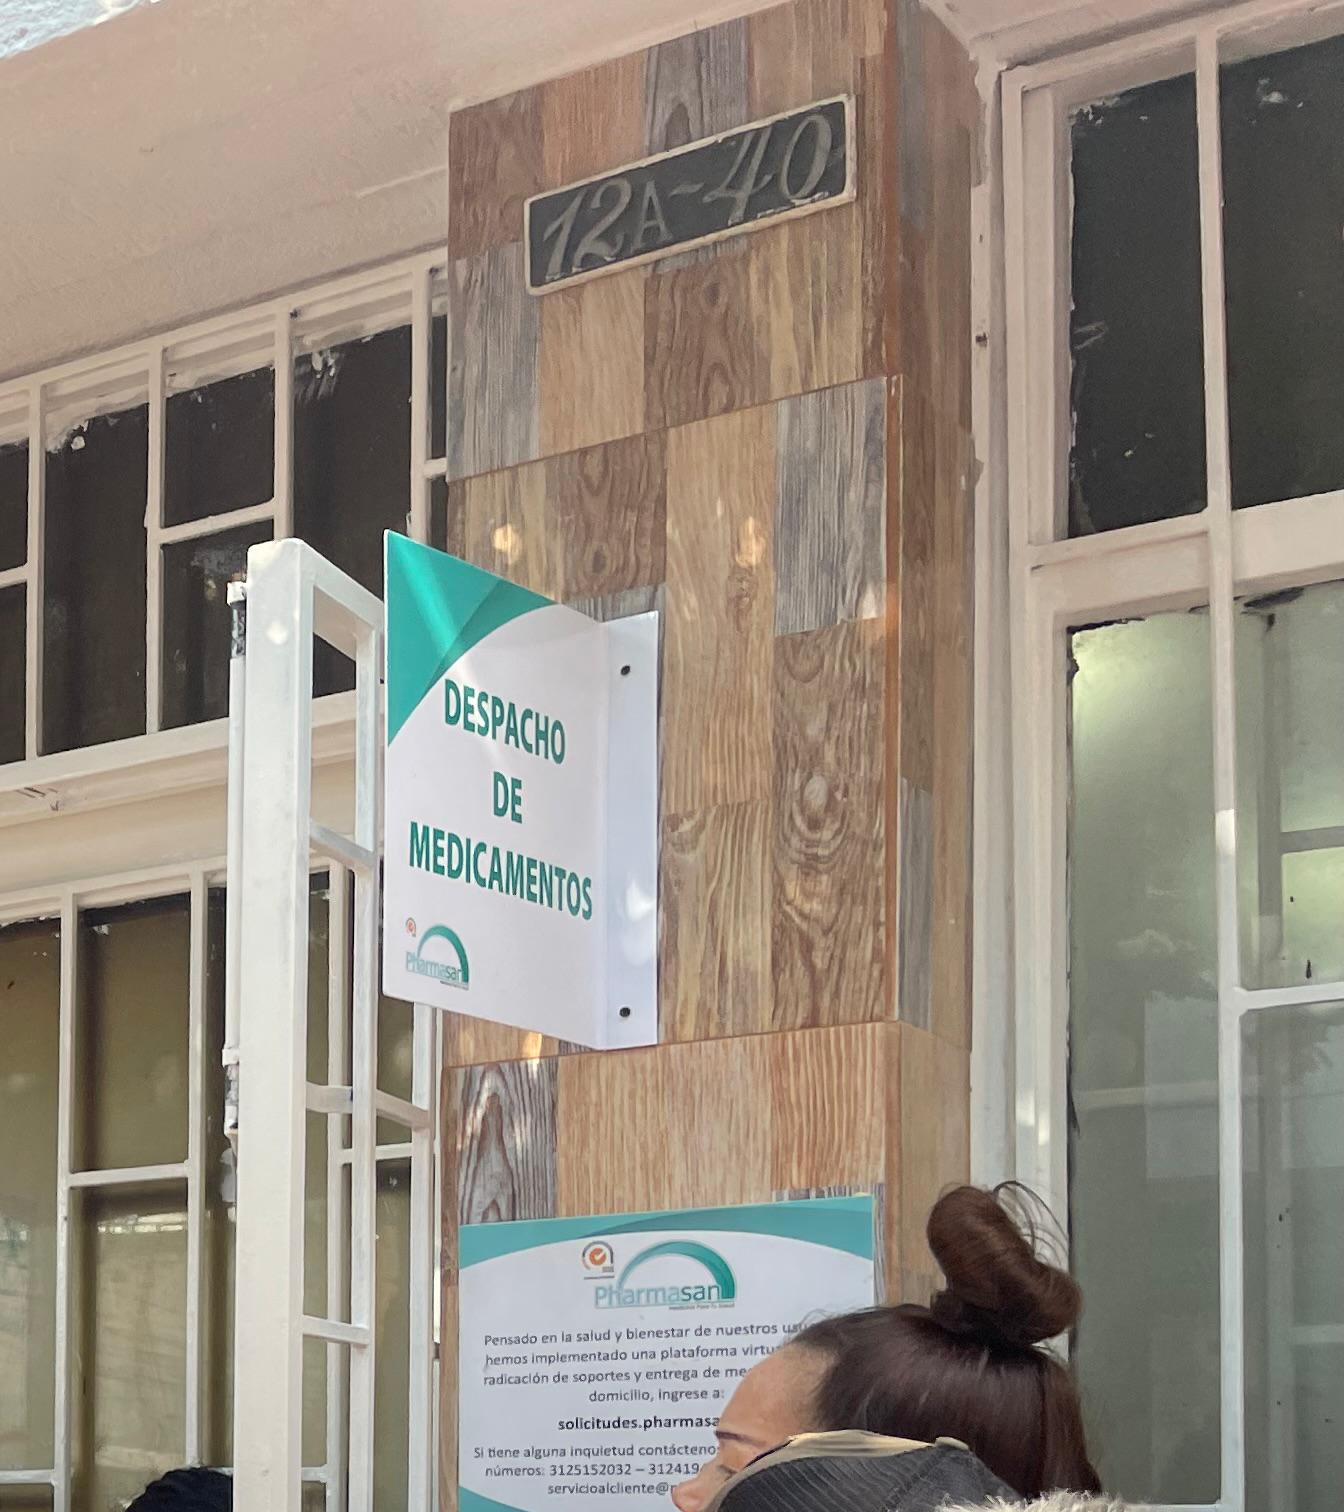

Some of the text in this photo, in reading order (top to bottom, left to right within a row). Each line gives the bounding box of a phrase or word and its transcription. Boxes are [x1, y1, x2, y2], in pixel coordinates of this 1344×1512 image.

[543, 113, 833, 281] 12A-40
[444, 677, 567, 766] DESPACHO
[493, 770, 524, 825] DE
[408, 820, 594, 921] MEDICAMENTOS
[594, 1284, 720, 1307] Pharmasan
[484, 1334, 538, 1347] Pensado
[541, 1334, 557, 1344] en
[561, 1331, 573, 1343] la
[576, 1330, 611, 1342] salud
[614, 1332, 624, 1344] y
[626, 1327, 690, 1341] bienestar
[694, 1325, 712, 1337] de
[715, 1322, 778, 1337] nuestros
[485, 1344, 776, 1367] hemos implementado una plataforma virtu
[484, 1366, 749, 1386] radicación de soportes y entrega de me
[589, 1387, 724, 1403] domicilio, ingrese a:
[558, 1415, 720, 1432] solicitudes.pharmasa
[473, 1447, 485, 1459] Si
[488, 1446, 520, 1459] tiene
[523, 1445, 566, 1461] alguna
[569, 1443, 635, 1460] inquietud
[485, 1463, 546, 1477] números:
[549, 1462, 632, 1477] 3125152032
[648, 1462, 702, 1476] 312419
